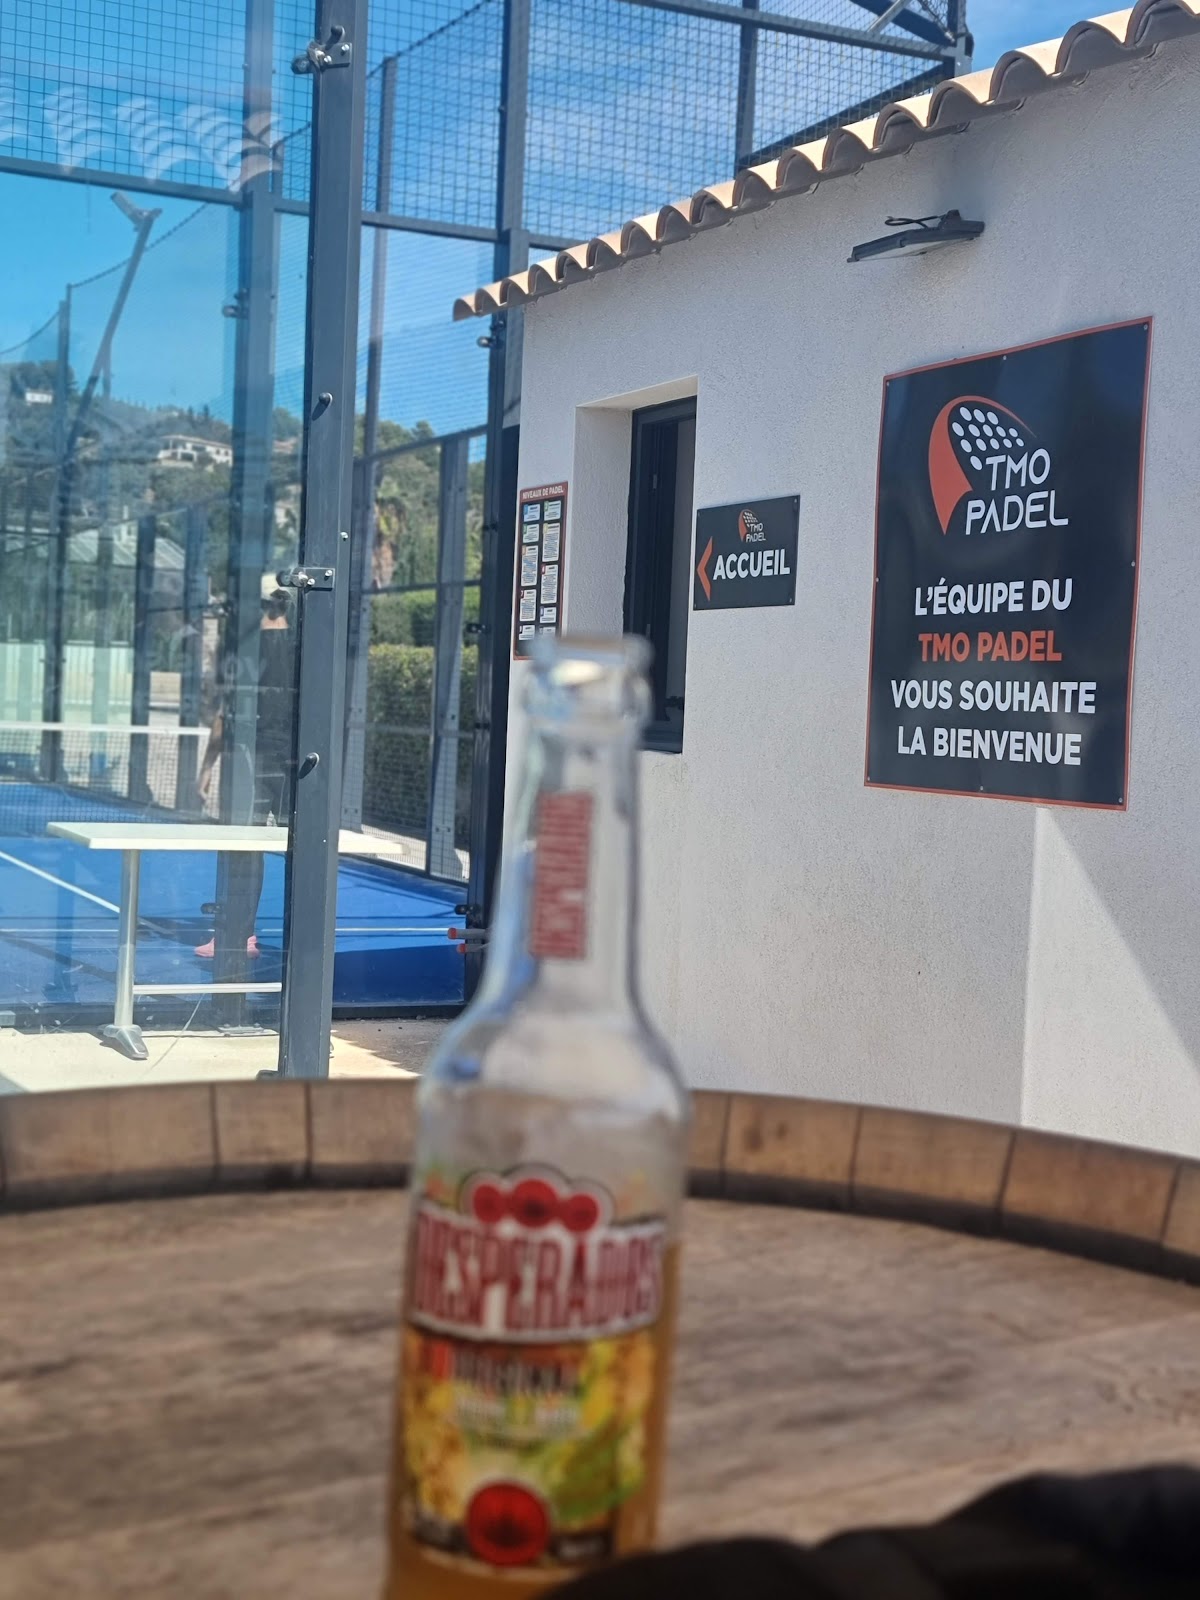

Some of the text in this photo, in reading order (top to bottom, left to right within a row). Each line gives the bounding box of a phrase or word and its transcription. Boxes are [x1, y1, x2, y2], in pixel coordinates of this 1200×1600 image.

[985, 448, 1051, 491] TMO
[522, 485, 564, 500] NIVEAUX DE PADEL
[749, 522, 764, 533] TMO
[965, 489, 1069, 536] PADEL
[745, 532, 767, 543] PADEL
[712, 548, 791, 581] ACCUEIL
[914, 577, 1073, 616] L'ÉQUIPE DU
[918, 630, 1063, 663] TMO PADEL
[890, 679, 1097, 714] VOUS SOUHAITE
[897, 725, 1082, 766] LA BIENVENUE
